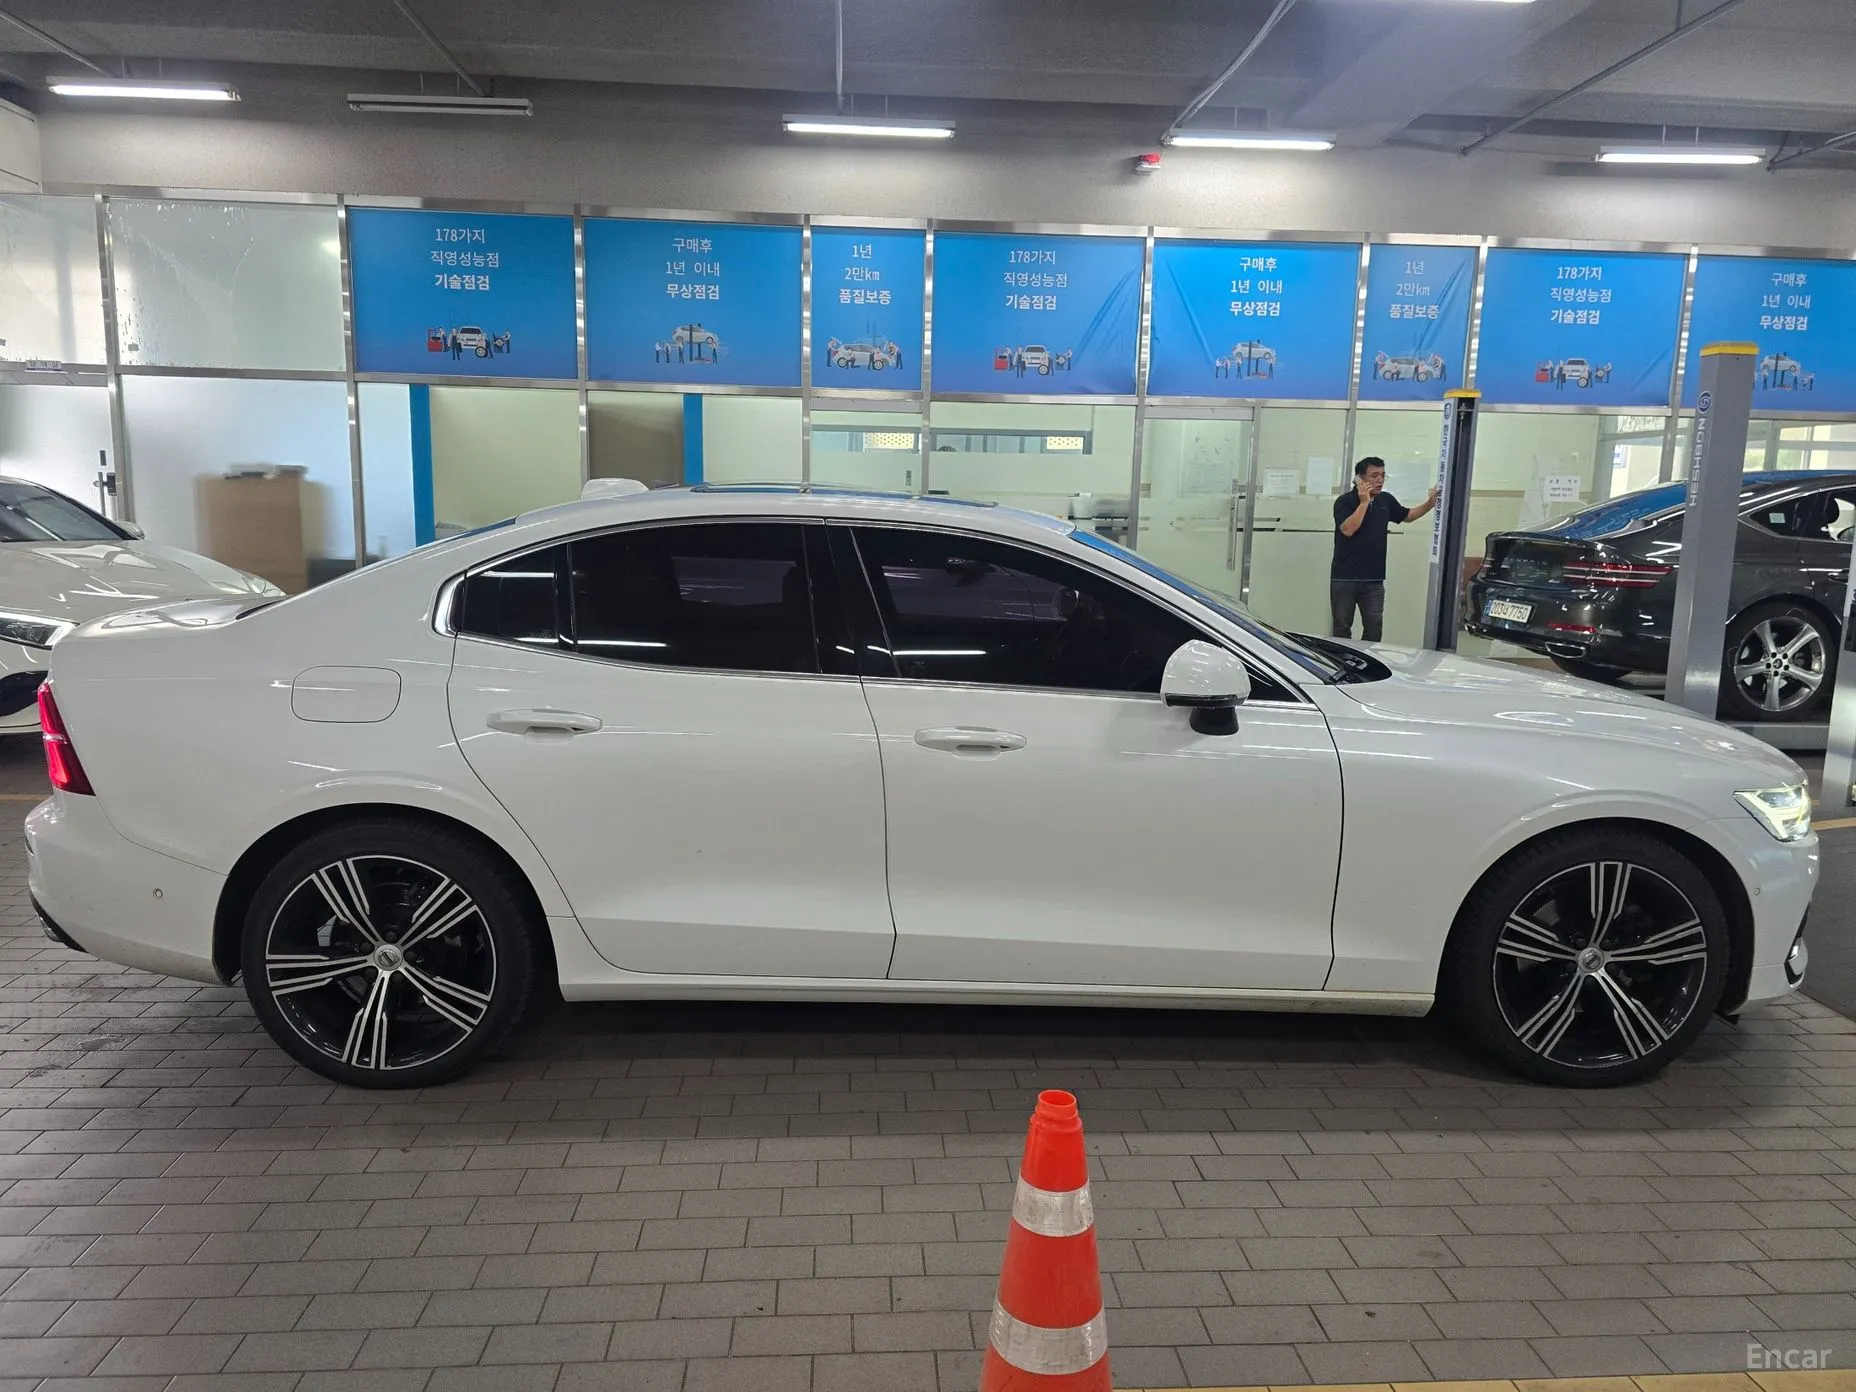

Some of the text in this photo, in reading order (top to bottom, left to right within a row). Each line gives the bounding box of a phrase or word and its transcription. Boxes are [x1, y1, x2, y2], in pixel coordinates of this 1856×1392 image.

[435, 227, 484, 243] 178가지
[671, 237, 712, 253] 구매후
[852, 243, 871, 258] 1년
[430, 250, 498, 267] 직영성능점
[1009, 249, 1055, 265] 178가지
[1239, 256, 1276, 272] 구매후
[665, 260, 719, 276] 1년 이내
[1405, 260, 1424, 274] 1년
[1556, 266, 1602, 280] 178가지
[434, 273, 489, 290] 기술점검
[1003, 271, 1067, 287] 직영성능점
[1230, 279, 1282, 294] 1년 이내
[1770, 272, 1806, 287] 구매후
[665, 283, 719, 299] 무상점검
[839, 288, 891, 304] 품질보증
[1550, 286, 1611, 303] 직영성능점
[1005, 294, 1056, 310] 기술점검
[1229, 301, 1280, 316] 무상점검
[1761, 294, 1810, 309] 1년 이내
[1389, 303, 1439, 319] 품질보증
[1550, 308, 1600, 324] 기술점검
[1759, 314, 1807, 330] 무상점검
[1689, 417, 1706, 507] HESHBON
